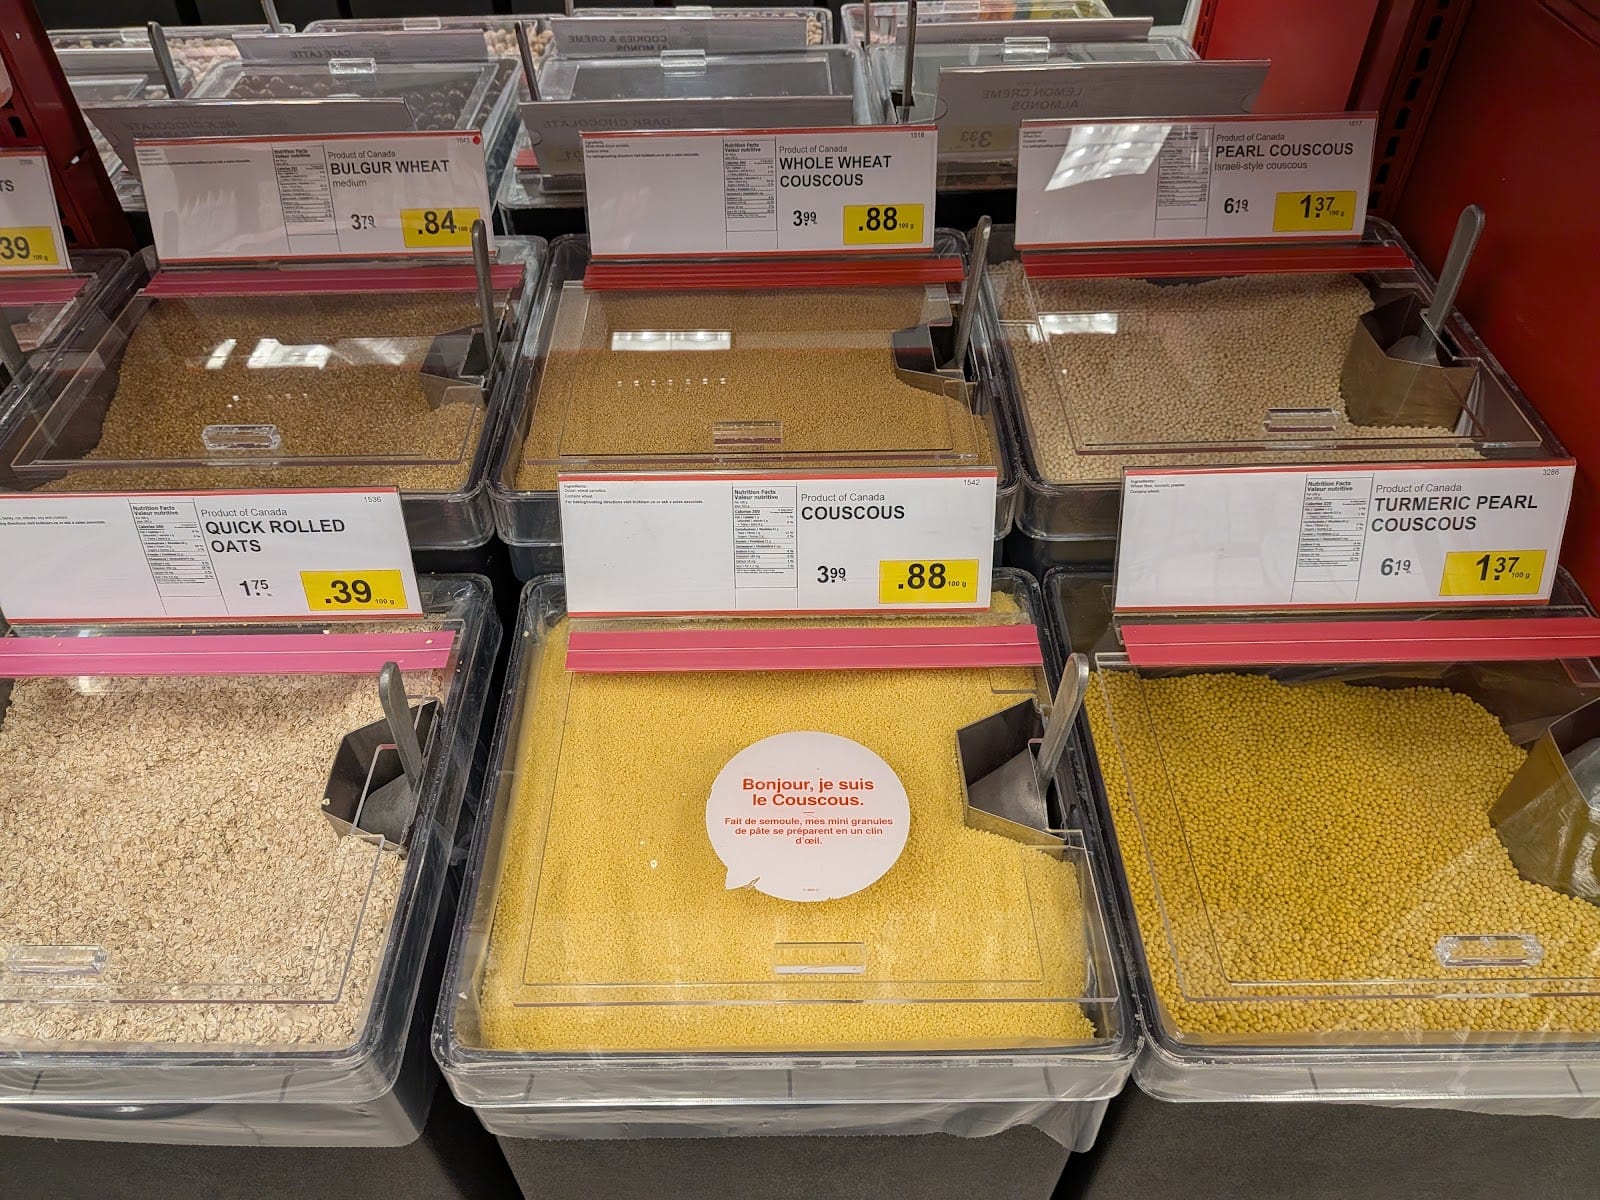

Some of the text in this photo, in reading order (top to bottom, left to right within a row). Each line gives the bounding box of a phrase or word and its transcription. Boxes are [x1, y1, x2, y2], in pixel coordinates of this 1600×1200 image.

[1216, 133, 1285, 142] Product of Canada
[328, 151, 357, 159] Product
[367, 150, 396, 158] Canada
[779, 145, 848, 154] Product of Canada
[1215, 143, 1354, 158] PEARL COUSCOUS
[331, 160, 449, 175] BULGUR WHEAT
[779, 155, 892, 170] WHOLE WHEAT
[1214, 160, 1308, 172] Israeli-style couscous
[332, 179, 367, 187] medium
[780, 174, 864, 188] COUSCOUS
[1224, 197, 1248, 214] 6.19
[1300, 194, 1335, 219] 1.37
[350, 213, 375, 230] 3.79
[418, 209, 457, 235] .84
[793, 210, 817, 227] 3.99
[858, 207, 898, 232] .88
[1375, 483, 1462, 493] Product of Canada
[801, 492, 885, 502] Product of Canada
[1374, 496, 1471, 512] TURMERIC
[1476, 495, 1538, 510] PEARL
[201, 507, 288, 518] Product of Canada
[801, 505, 905, 521] COUSCOUS
[205, 519, 345, 535] QUICK ROLLED
[1371, 516, 1477, 532] COUSCOUS
[211, 539, 262, 553] OATS
[816, 565, 846, 584] 3.99
[1380, 557, 1411, 577] 6.19
[1475, 554, 1520, 581] 1.37
[898, 563, 946, 590] .88
[1524, 572, 1531, 580] g
[239, 579, 269, 597] 1.75
[325, 579, 372, 605] .39
[742, 777, 874, 793] Bonjour, je suis
[752, 794, 864, 806] le Couscous.
[724, 817, 742, 825] Fait
[744, 817, 757, 825] de
[759, 817, 803, 827] semoule,
[828, 817, 849, 825] mini
[851, 817, 894, 827] granules
[735, 827, 747, 835] de
[749, 827, 770, 837] pâte
[786, 827, 834, 837] préparent
[865, 827, 883, 835] clin
